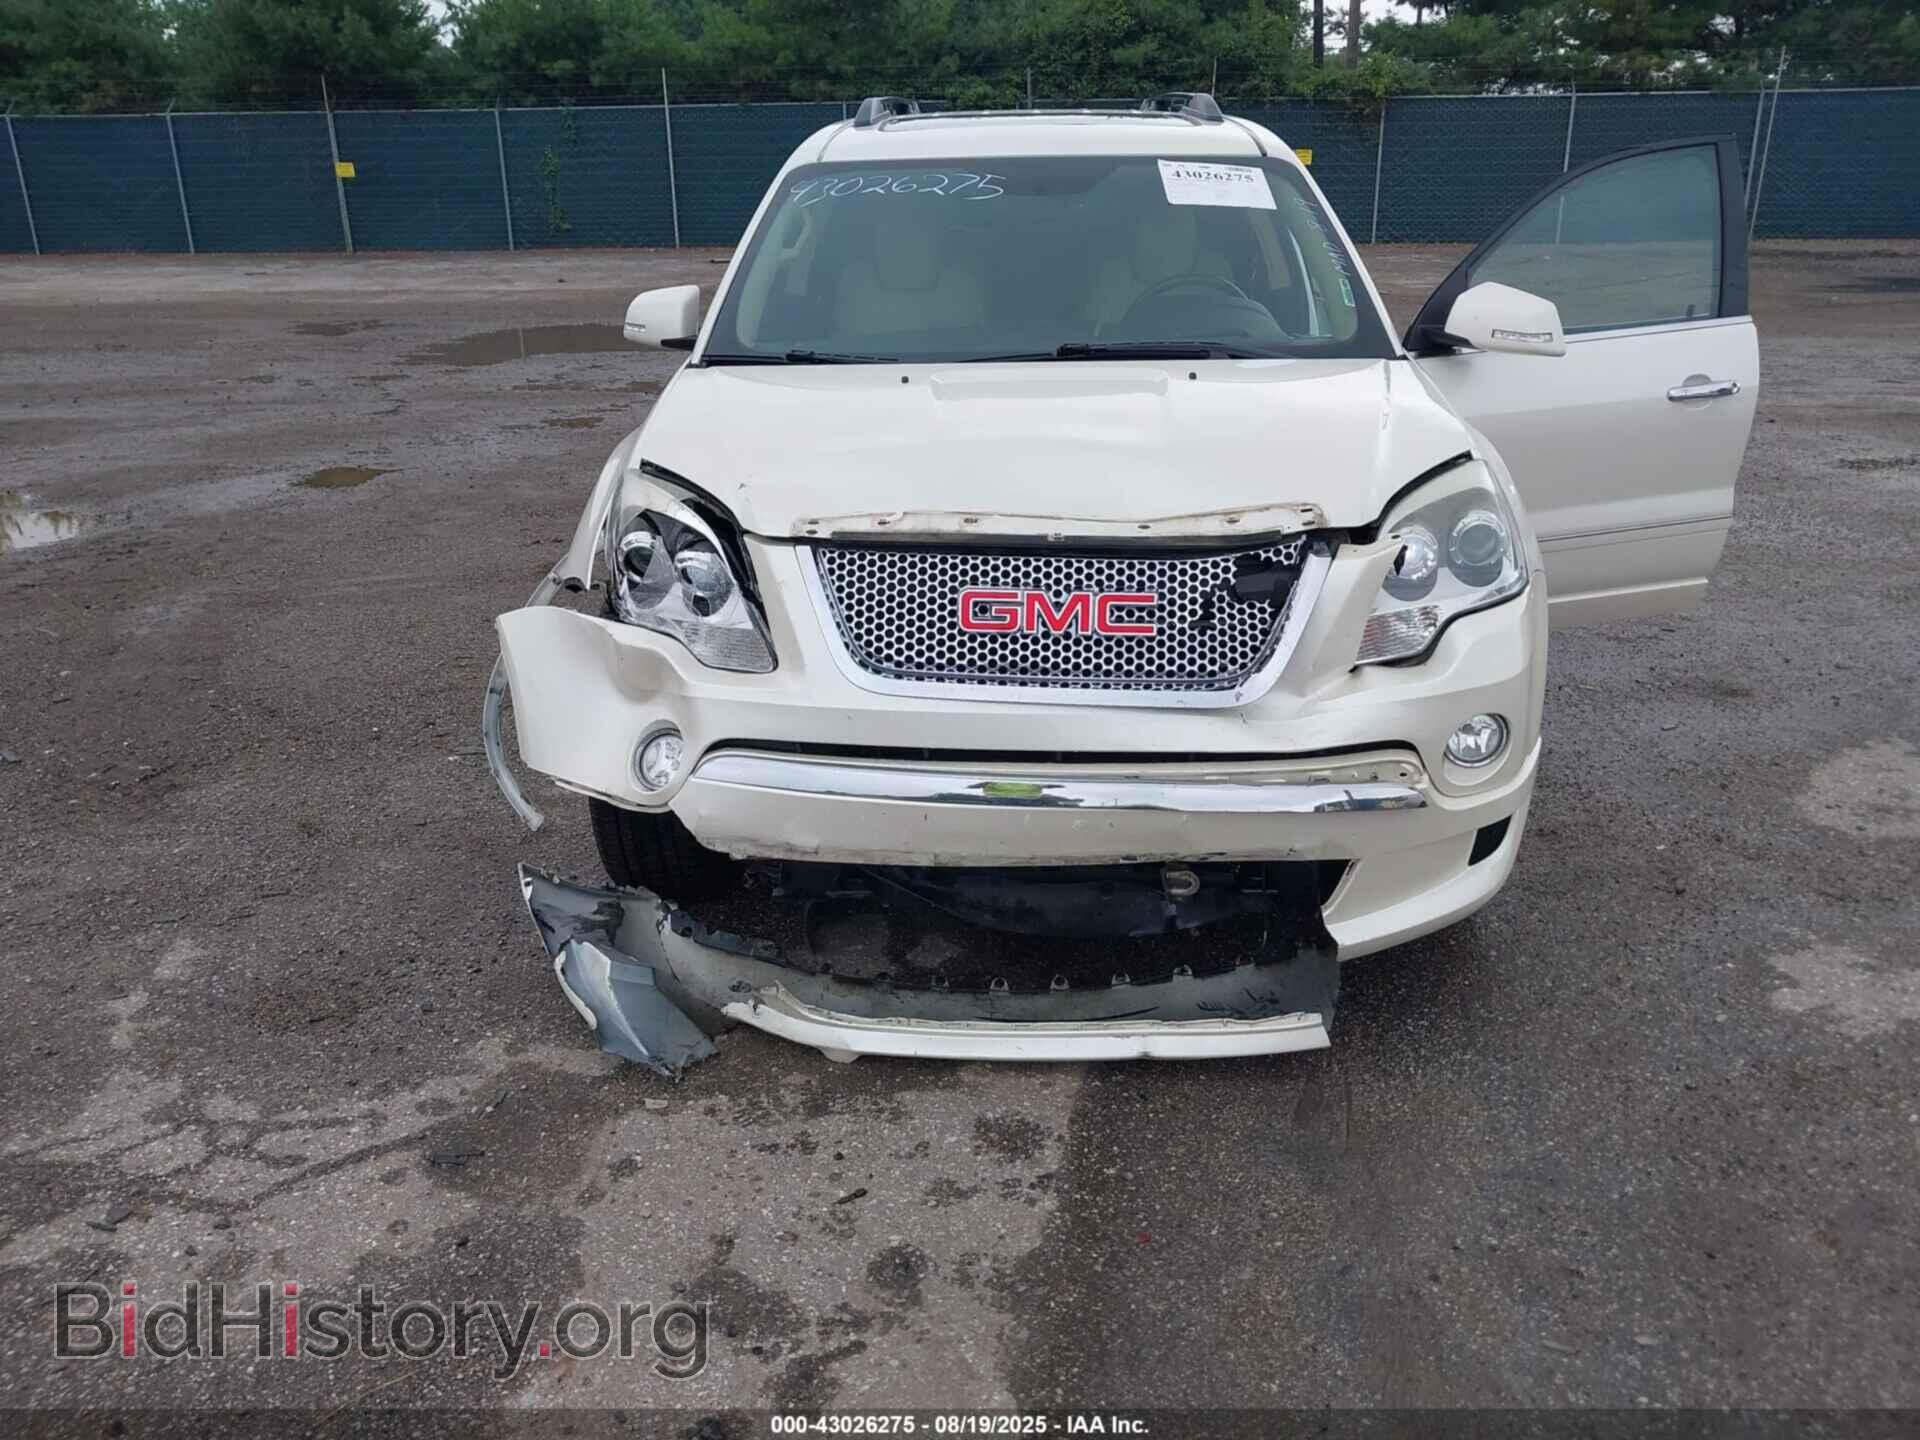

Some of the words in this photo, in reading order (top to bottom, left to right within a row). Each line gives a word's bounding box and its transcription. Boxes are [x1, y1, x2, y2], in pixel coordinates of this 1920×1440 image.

[790, 173, 1006, 207] 43026275
[1172, 170, 1255, 182] 43026275
[959, 586, 1158, 637] GMC
